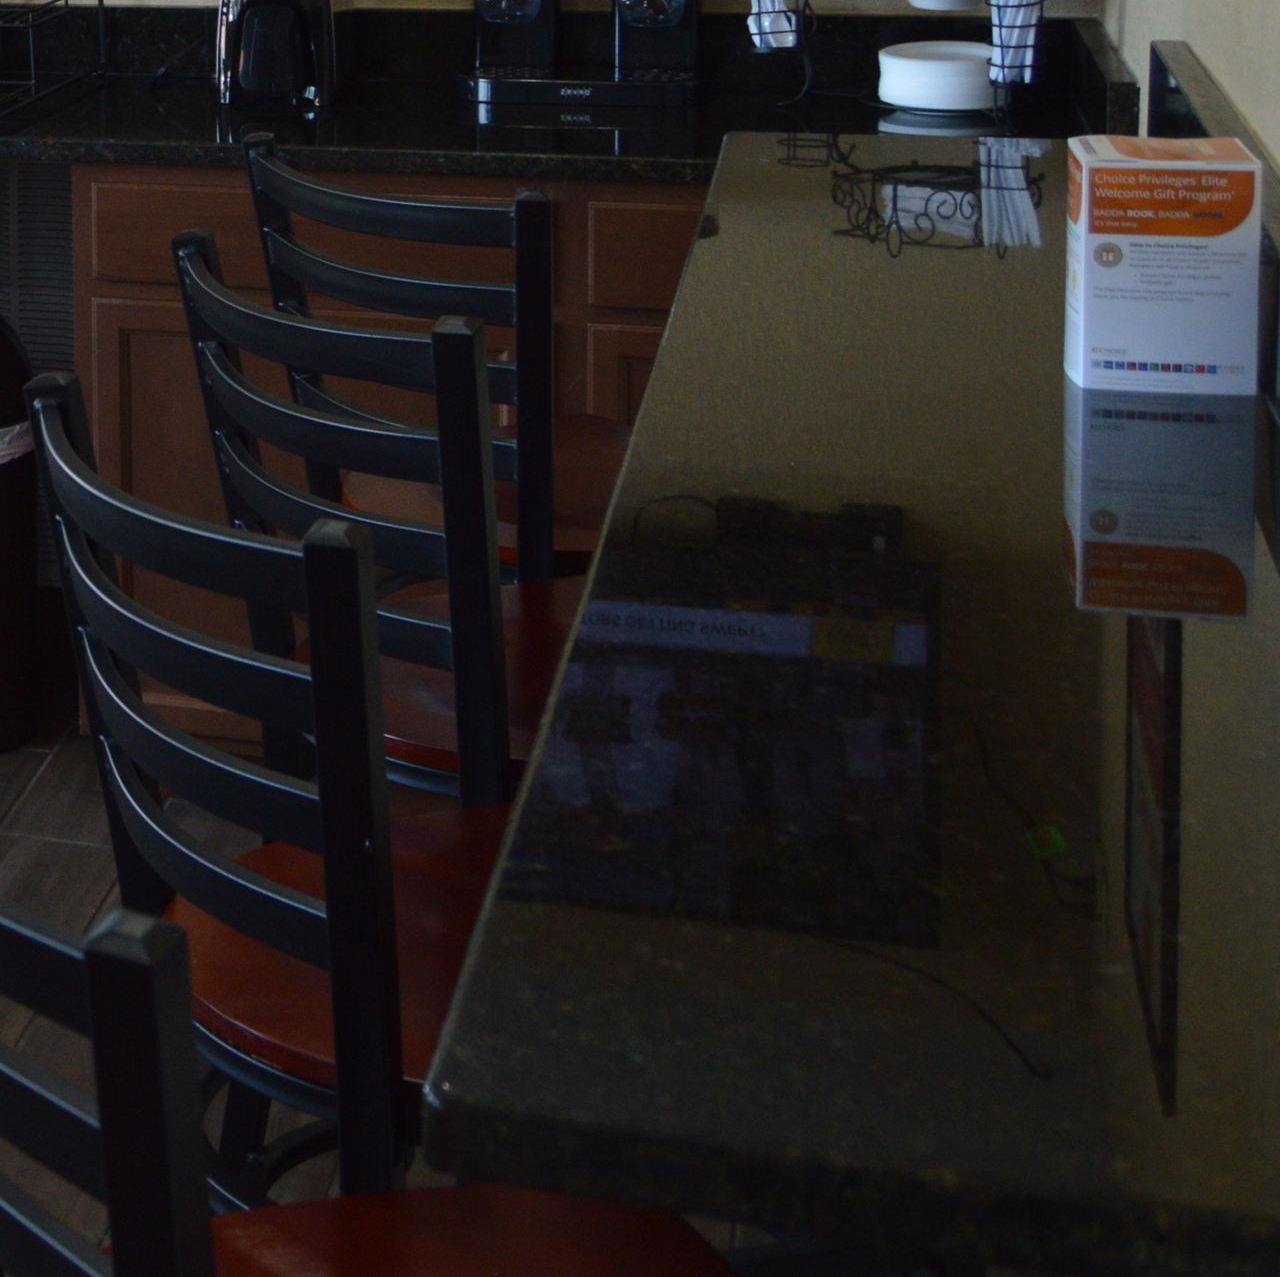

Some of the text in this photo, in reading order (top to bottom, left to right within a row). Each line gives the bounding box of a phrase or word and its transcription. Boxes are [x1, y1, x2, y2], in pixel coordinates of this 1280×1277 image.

[1094, 174, 1136, 185] Choice
[1201, 175, 1229, 187] Elite
[1094, 188, 1151, 199] Welcome
[1153, 189, 1176, 200] Gift
